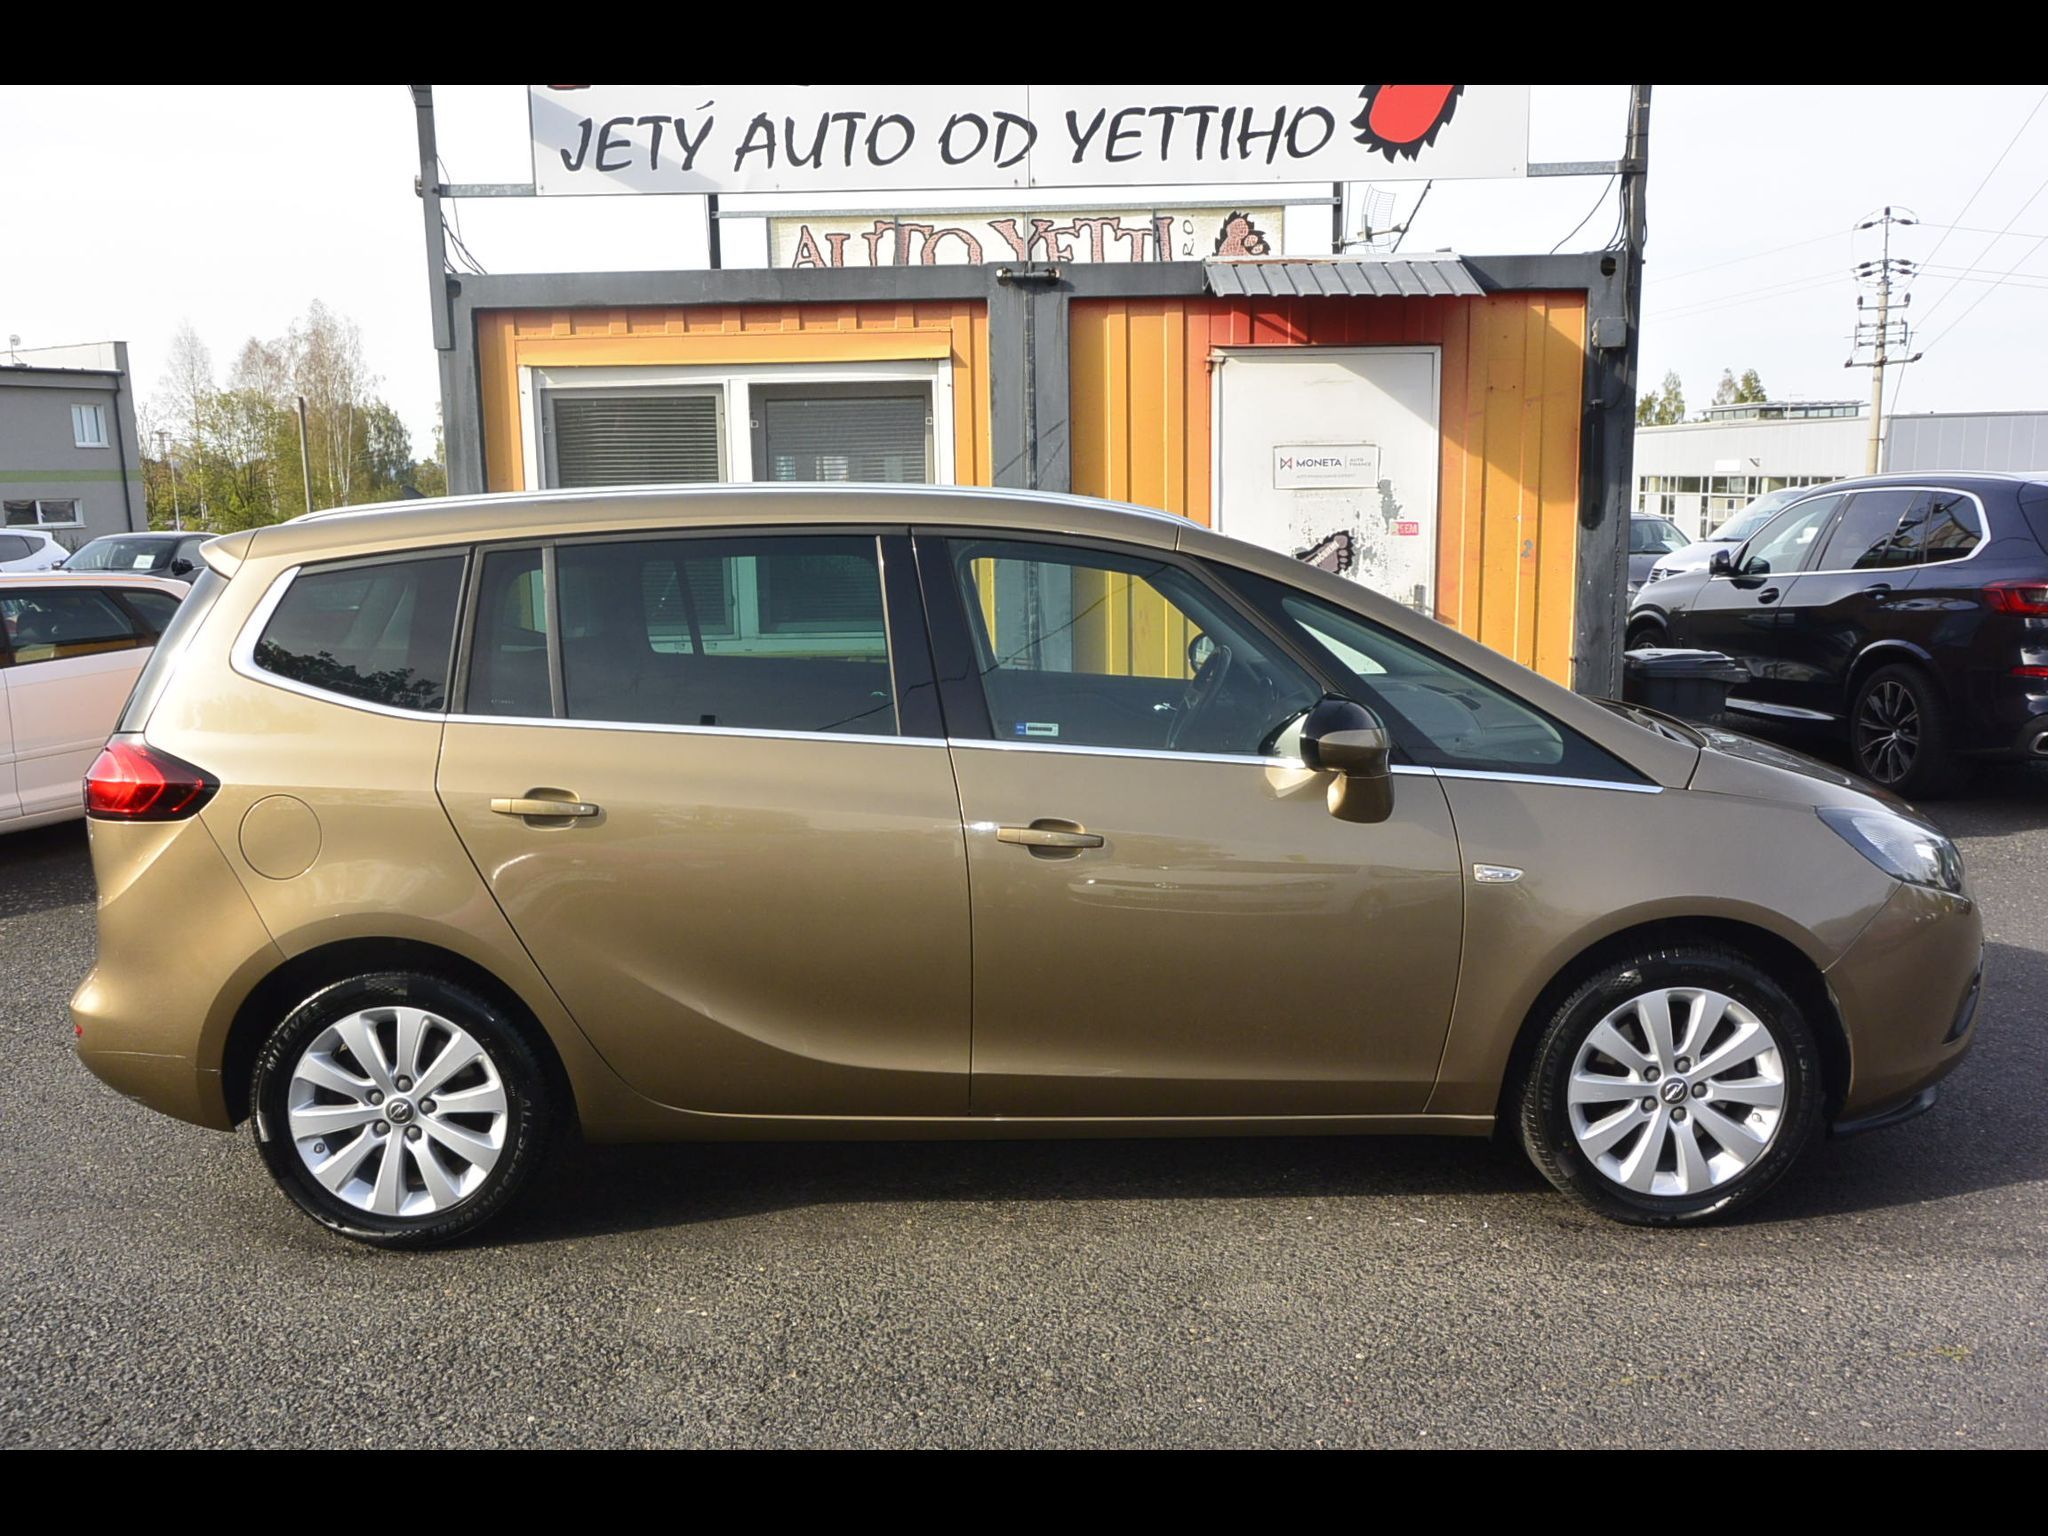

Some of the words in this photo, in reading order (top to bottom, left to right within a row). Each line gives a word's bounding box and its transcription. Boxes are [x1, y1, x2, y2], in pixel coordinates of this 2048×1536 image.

[560, 100, 715, 172] JETÝ
[733, 111, 916, 173] AUTO
[937, 111, 1039, 169] OD
[1064, 104, 1336, 166] YETTIHO
[1295, 457, 1343, 468] MONETA
